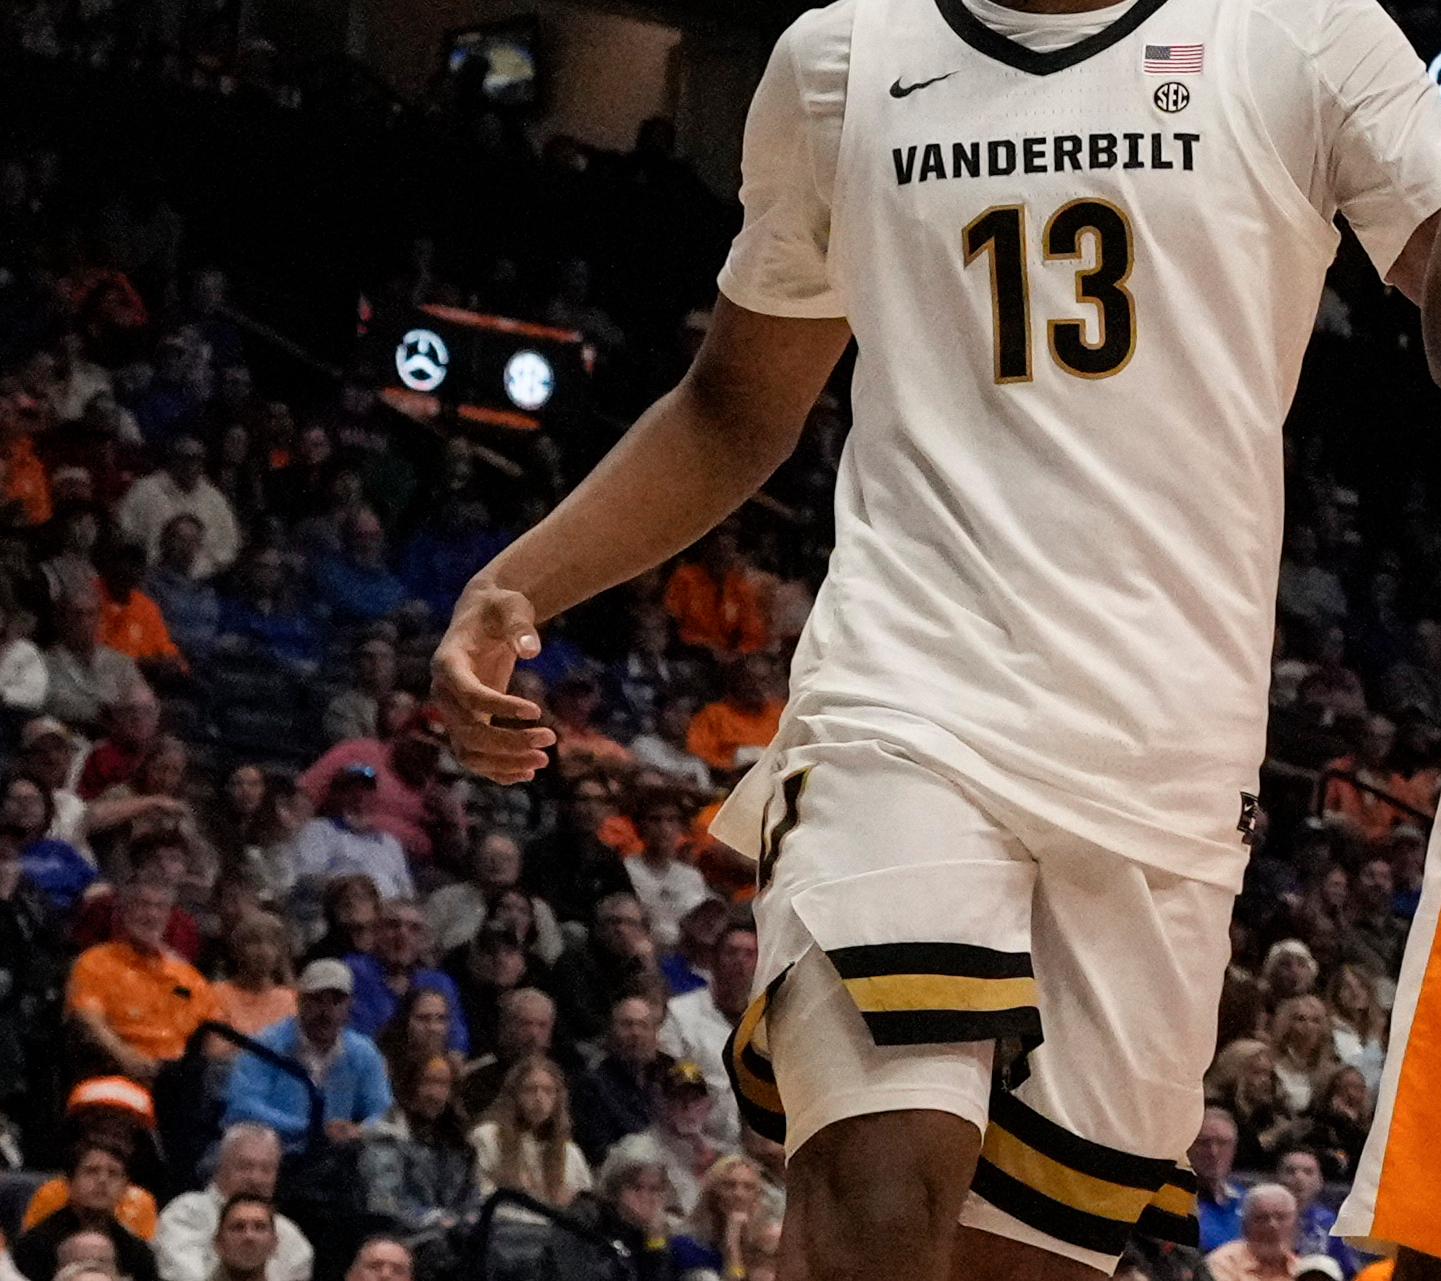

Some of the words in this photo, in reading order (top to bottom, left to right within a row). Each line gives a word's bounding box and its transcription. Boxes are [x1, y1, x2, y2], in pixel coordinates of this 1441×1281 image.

[1155, 82, 1190, 113] SEC
[891, 131, 1202, 186] VANDERBILT
[960, 197, 1136, 385] 13
